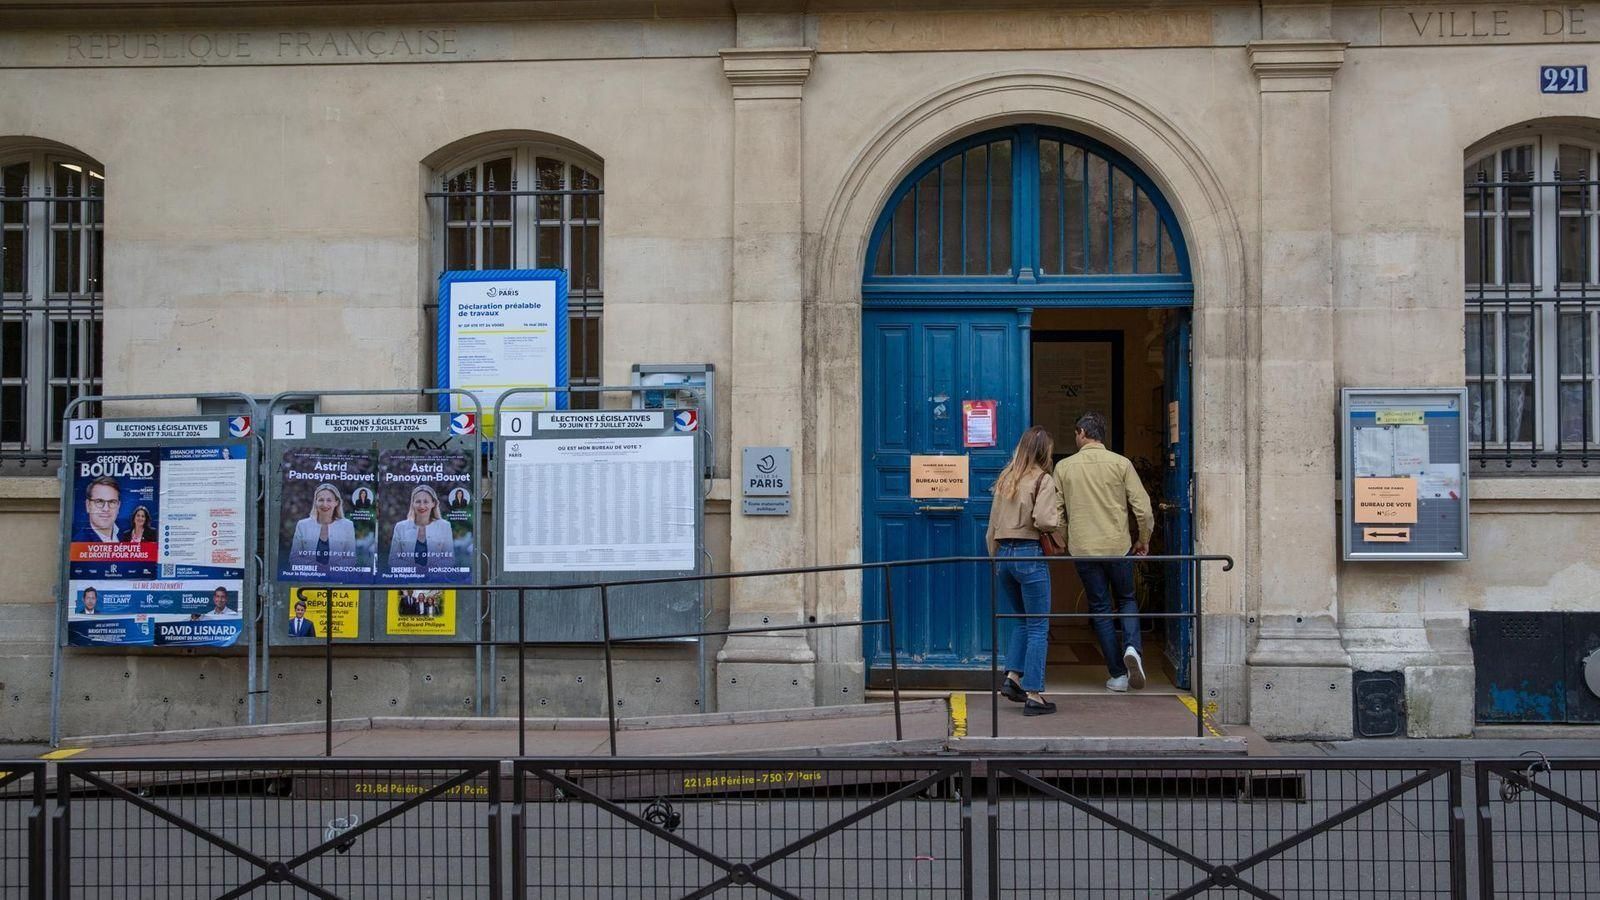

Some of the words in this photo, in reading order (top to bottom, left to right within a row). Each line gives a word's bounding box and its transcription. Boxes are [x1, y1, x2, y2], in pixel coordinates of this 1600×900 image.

[1407, 10, 1511, 38] VILLE
[1542, 9, 1587, 36] DE
[277, 29, 458, 60] FRANÇAISE
[1543, 67, 1585, 92] 221
[458, 302, 502, 310] Déclaration
[504, 302, 541, 311] préalable
[325, 418, 370, 426] ÉLECTIONS
[596, 414, 651, 422] LÉGISLATIVES
[158, 423, 208, 431] LÉGISLATIVES
[285, 420, 295, 436] 1
[511, 417, 522, 433] 0
[75, 425, 94, 440] 10
[97, 455, 140, 463] GEOFFROY
[81, 462, 155, 477] BOULARD
[314, 461, 348, 471] Astrid
[410, 462, 443, 473] Astrid
[288, 470, 375, 482] Panosyan-Bouvet
[385, 472, 471, 483] Panosyan-Bouvet
[750, 479, 783, 488] PARIS
[88, 544, 112, 552] VOTRE
[114, 542, 141, 552] DÉPUTÉ
[161, 626, 192, 636] DAVID
[194, 625, 237, 635] LISNARD
[796, 771, 822, 781] Paris
